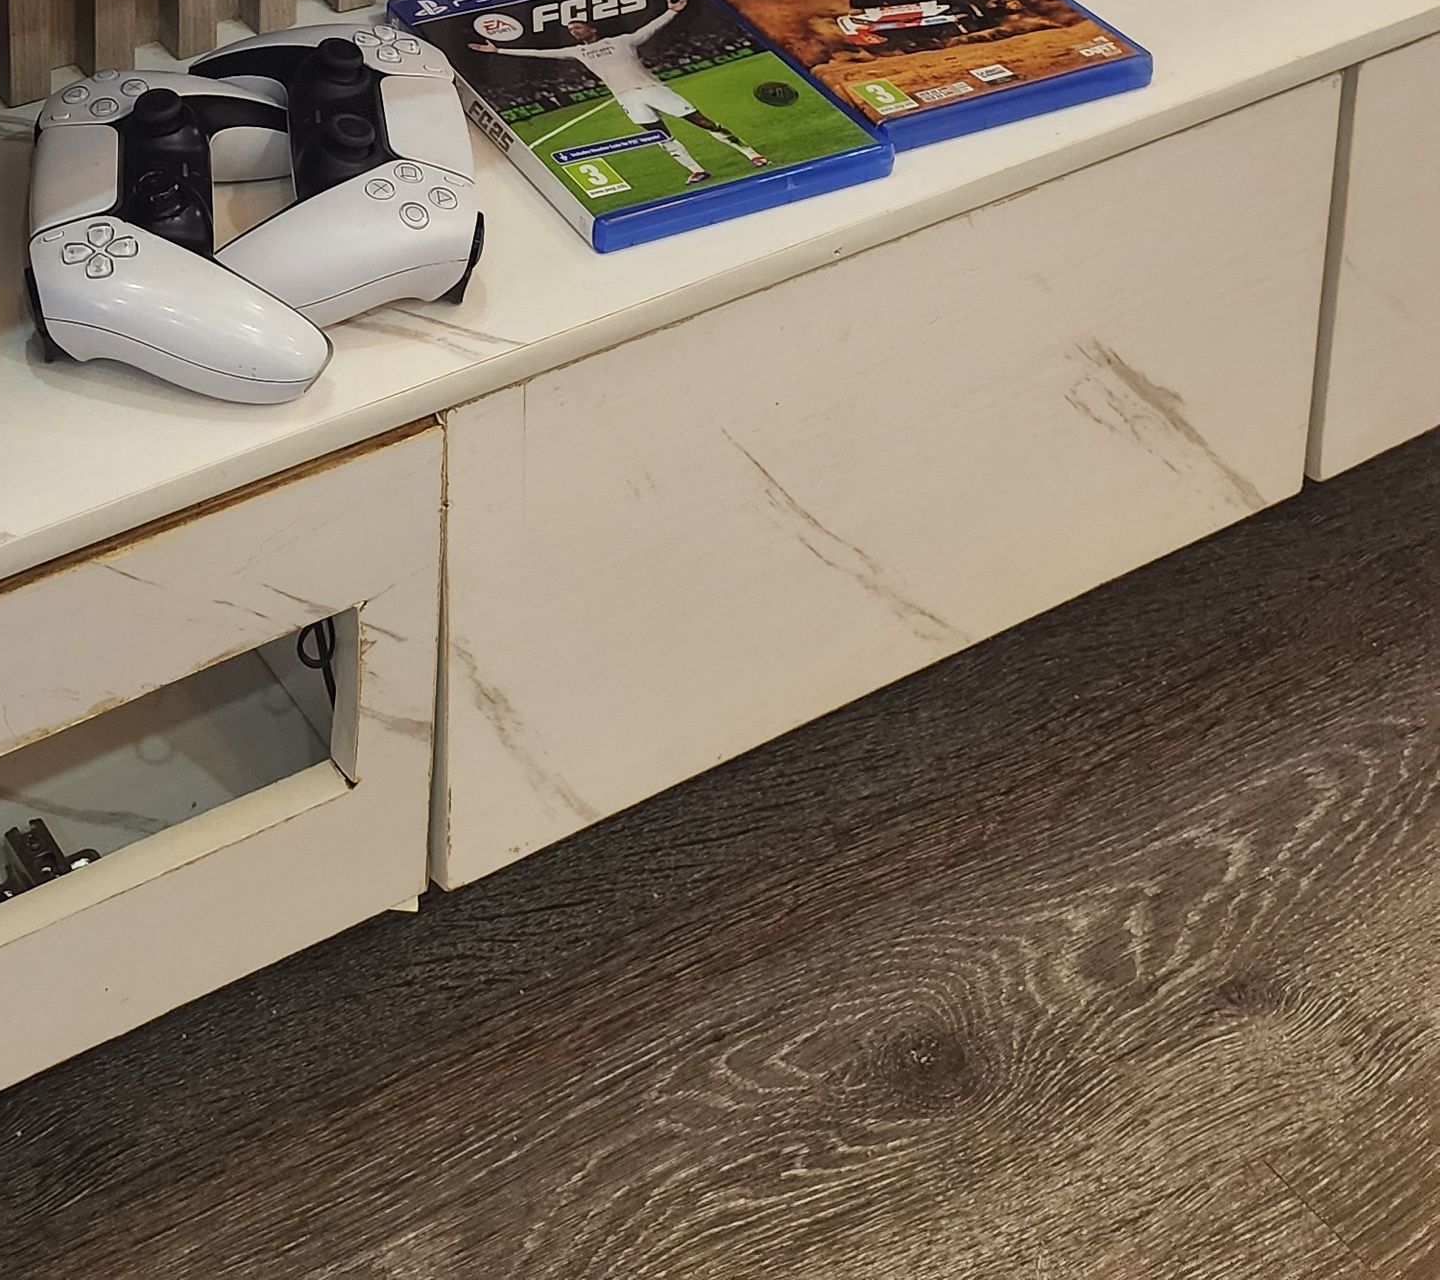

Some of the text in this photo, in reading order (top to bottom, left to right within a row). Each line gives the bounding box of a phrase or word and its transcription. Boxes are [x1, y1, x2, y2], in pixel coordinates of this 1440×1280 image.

[483, 19, 517, 32] EA
[865, 84, 896, 104] 3
[579, 164, 609, 186] 3
